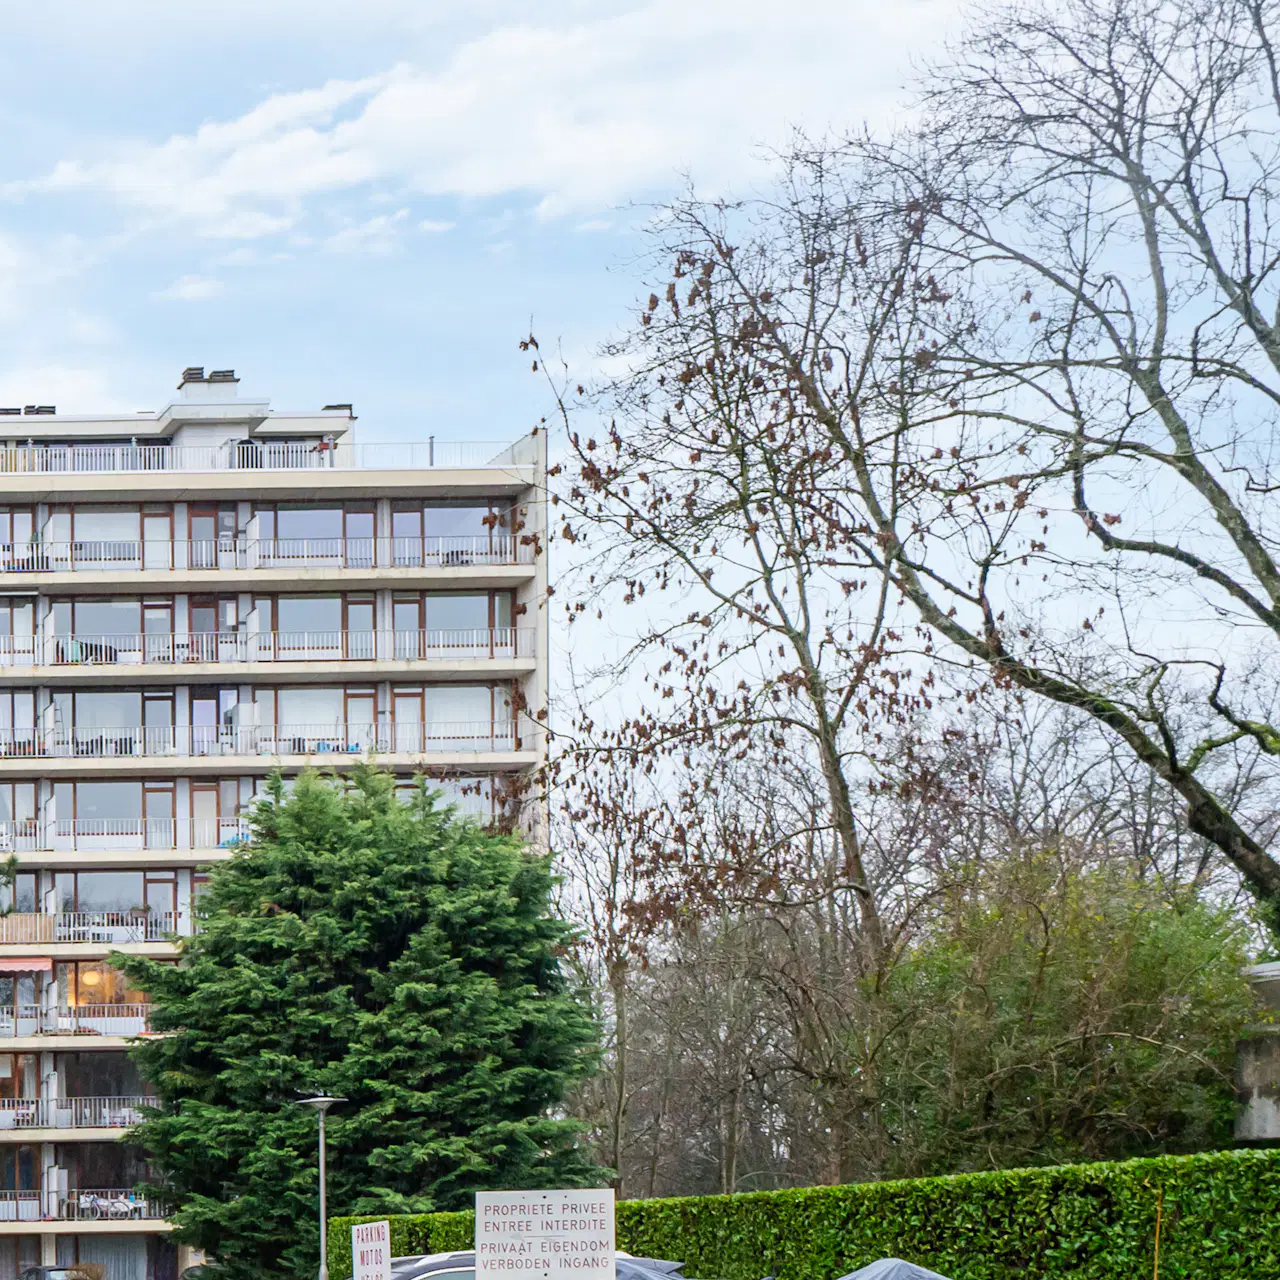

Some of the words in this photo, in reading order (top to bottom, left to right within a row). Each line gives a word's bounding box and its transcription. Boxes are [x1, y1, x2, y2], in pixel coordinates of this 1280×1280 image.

[484, 1203, 554, 1216] PROPRIETE
[562, 1202, 606, 1215] PRIVEE
[484, 1220, 532, 1232] ENTREE
[540, 1219, 607, 1231] INTERDITE
[356, 1224, 385, 1244] PARKING
[480, 1241, 533, 1254] PRIVAAT
[540, 1240, 610, 1253] EIGENDOM
[360, 1248, 383, 1266] MOTOS
[481, 1258, 551, 1270] VERBODEN
[559, 1257, 609, 1269] INGANG
